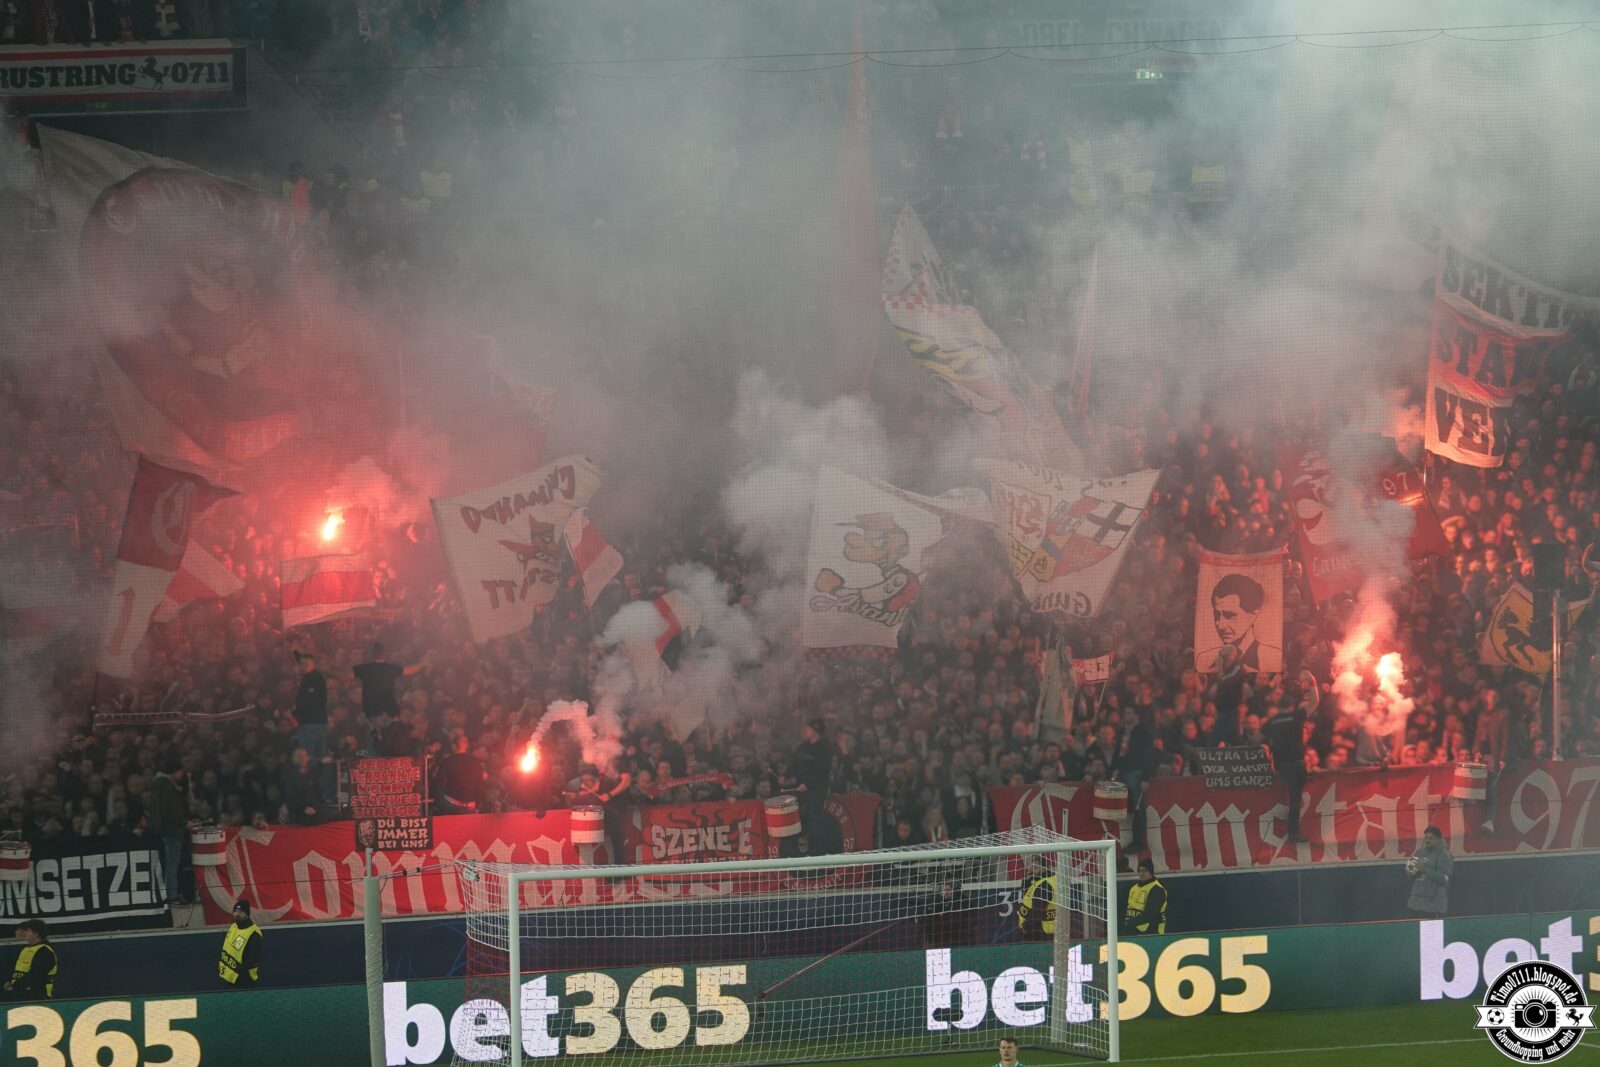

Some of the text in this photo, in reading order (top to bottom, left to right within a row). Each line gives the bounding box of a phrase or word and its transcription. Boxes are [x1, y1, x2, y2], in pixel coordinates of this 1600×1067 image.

[171, 62, 230, 83] 0711
[1383, 471, 1409, 496] 97
[358, 757, 413, 769] JEDER
[1199, 748, 1265, 761] ULTRA IST
[350, 767, 421, 783] VERBANNTE
[1203, 762, 1269, 774] DER KAMPF
[356, 781, 415, 795] KEHRT
[1206, 775, 1273, 788] UMS GANZE
[1510, 766, 1600, 851] 97
[377, 818, 428, 829] DU BIST
[377, 828, 428, 840] IMMER
[651, 824, 730, 860] SZENE
[377, 839, 429, 849] BEI UNS!
[843, 837, 856, 854] 97
[0, 849, 168, 915] MSETZEN
[998, 890, 1022, 917] 3
[926, 935, 1271, 1031] bet365
[383, 964, 750, 1066] bet365
[7, 998, 201, 1067] 365
